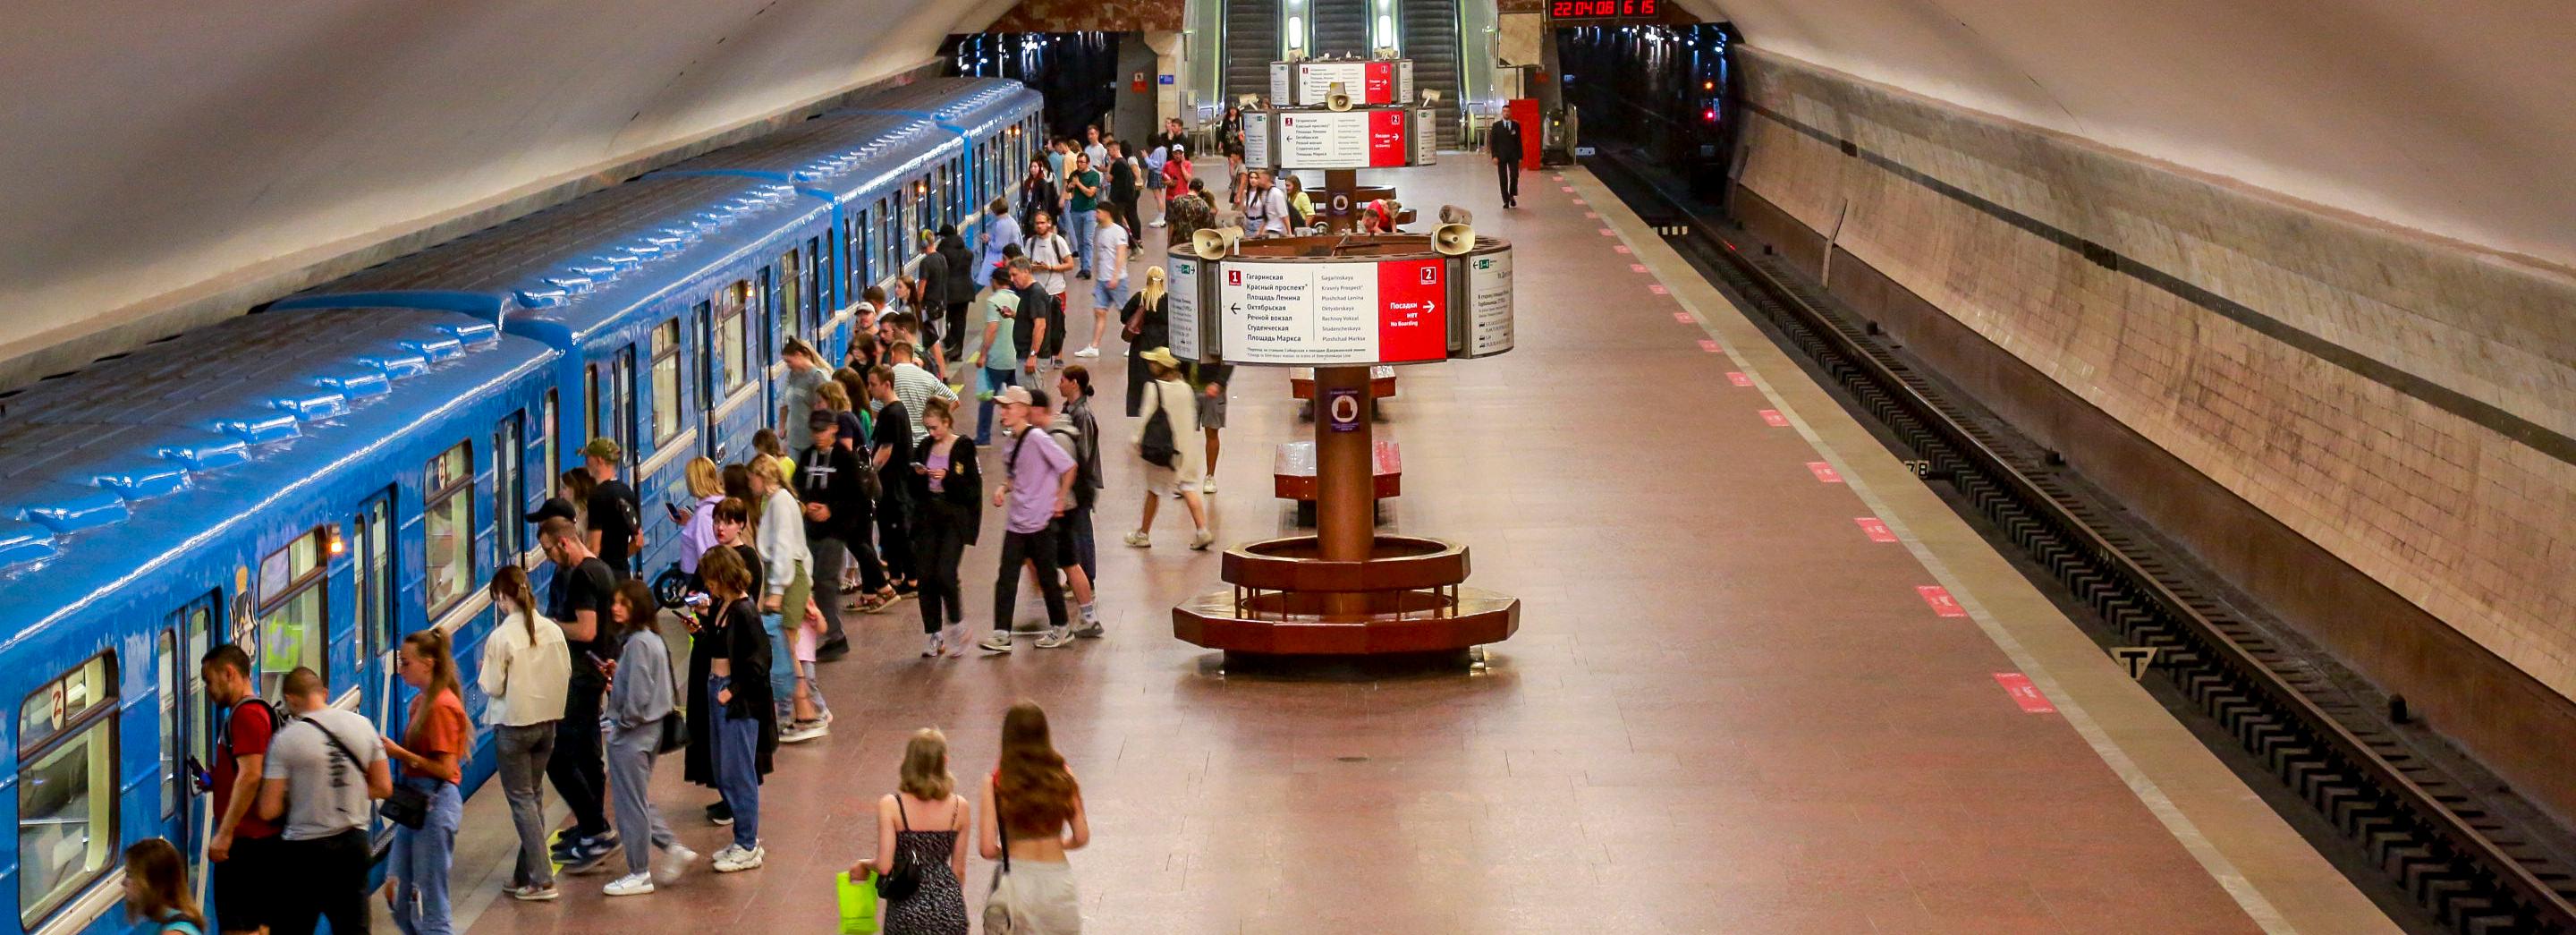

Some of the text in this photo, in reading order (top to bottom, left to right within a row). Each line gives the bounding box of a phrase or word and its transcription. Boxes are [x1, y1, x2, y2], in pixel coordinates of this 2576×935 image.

[1554, 0, 1654, 16] 22 04 08 6 15
[1232, 271, 1238, 282] 1
[1246, 273, 1284, 281] Гагаринская
[1426, 268, 1432, 280] 2
[1246, 284, 1274, 292] Красный
[1246, 293, 1275, 302] Площадь
[1247, 303, 1286, 311] Октябрьская
[1390, 302, 1418, 310] Посадки
[1247, 313, 1269, 321] Речной
[1247, 324, 1289, 333] Студенческая
[1247, 334, 1275, 342] Площадь
[1905, 463, 1928, 477] 78
[53, 690, 62, 718] 2
